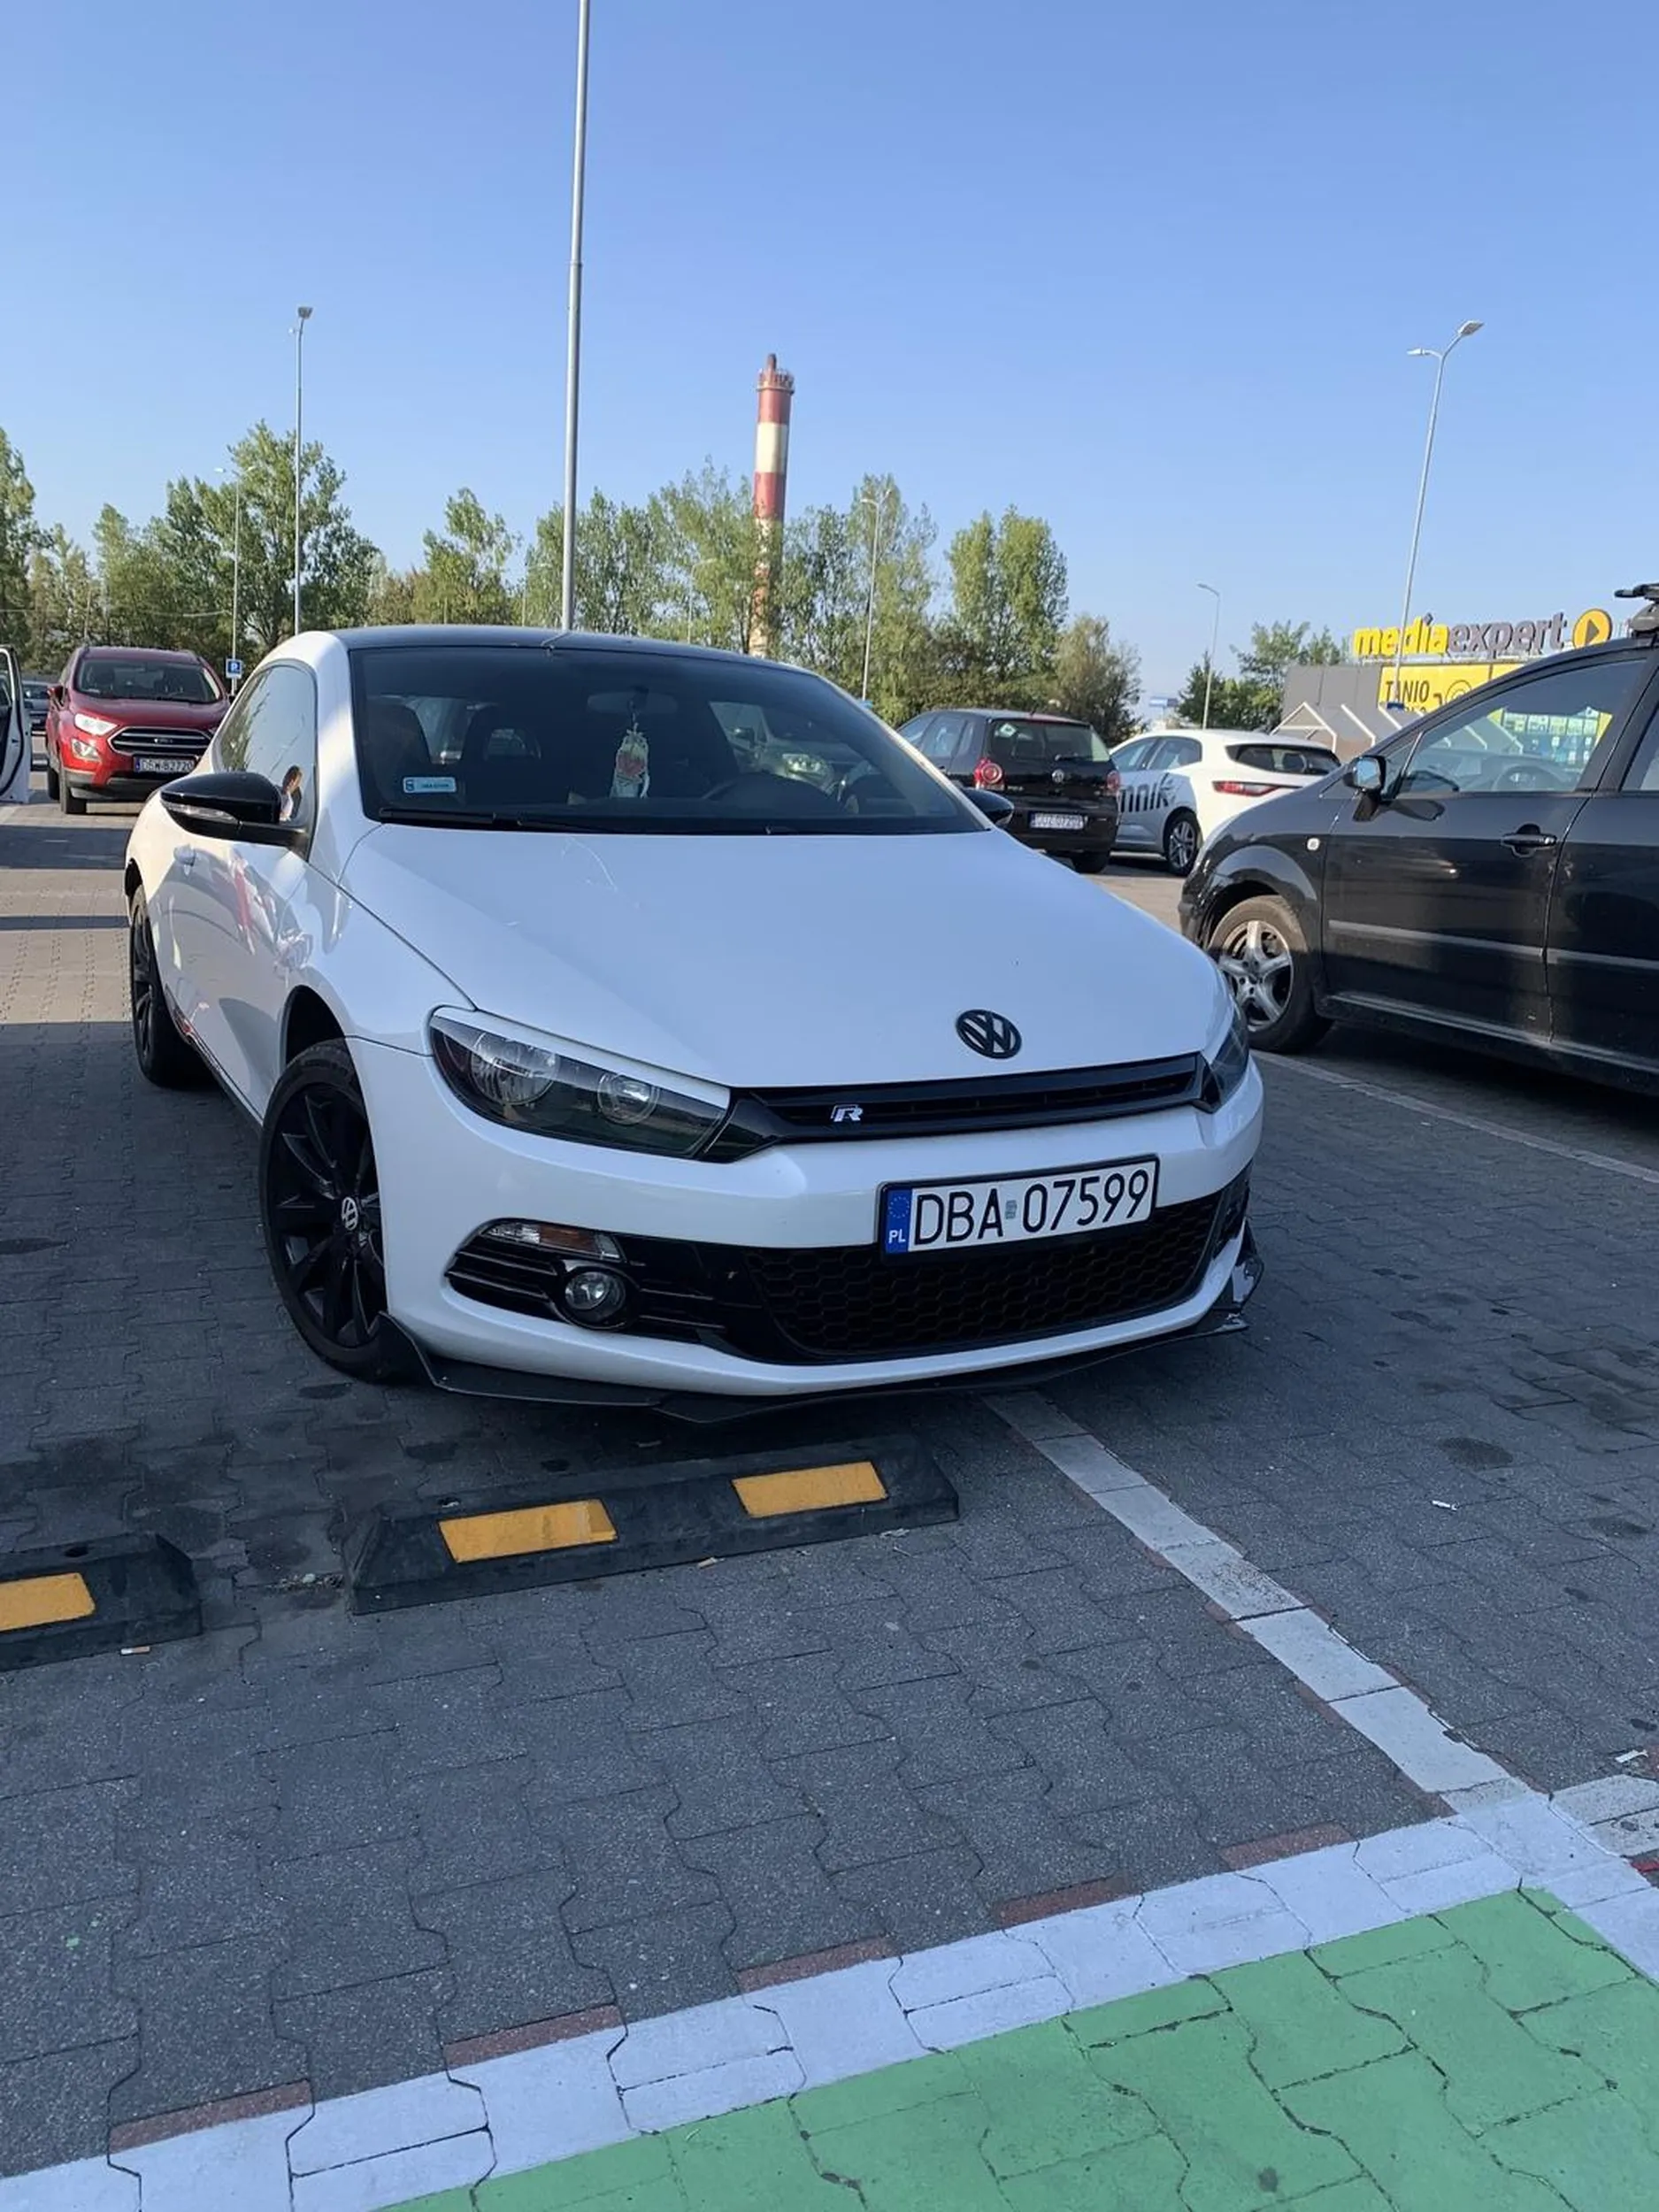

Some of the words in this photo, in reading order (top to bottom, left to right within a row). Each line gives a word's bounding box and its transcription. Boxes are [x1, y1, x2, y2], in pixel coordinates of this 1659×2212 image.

[1353, 611, 1568, 658] mediaexpert
[831, 1104, 864, 1122] R
[914, 1188, 1004, 1246] DBA
[1023, 1169, 1150, 1233] 07599
[887, 1229, 906, 1244] PL
